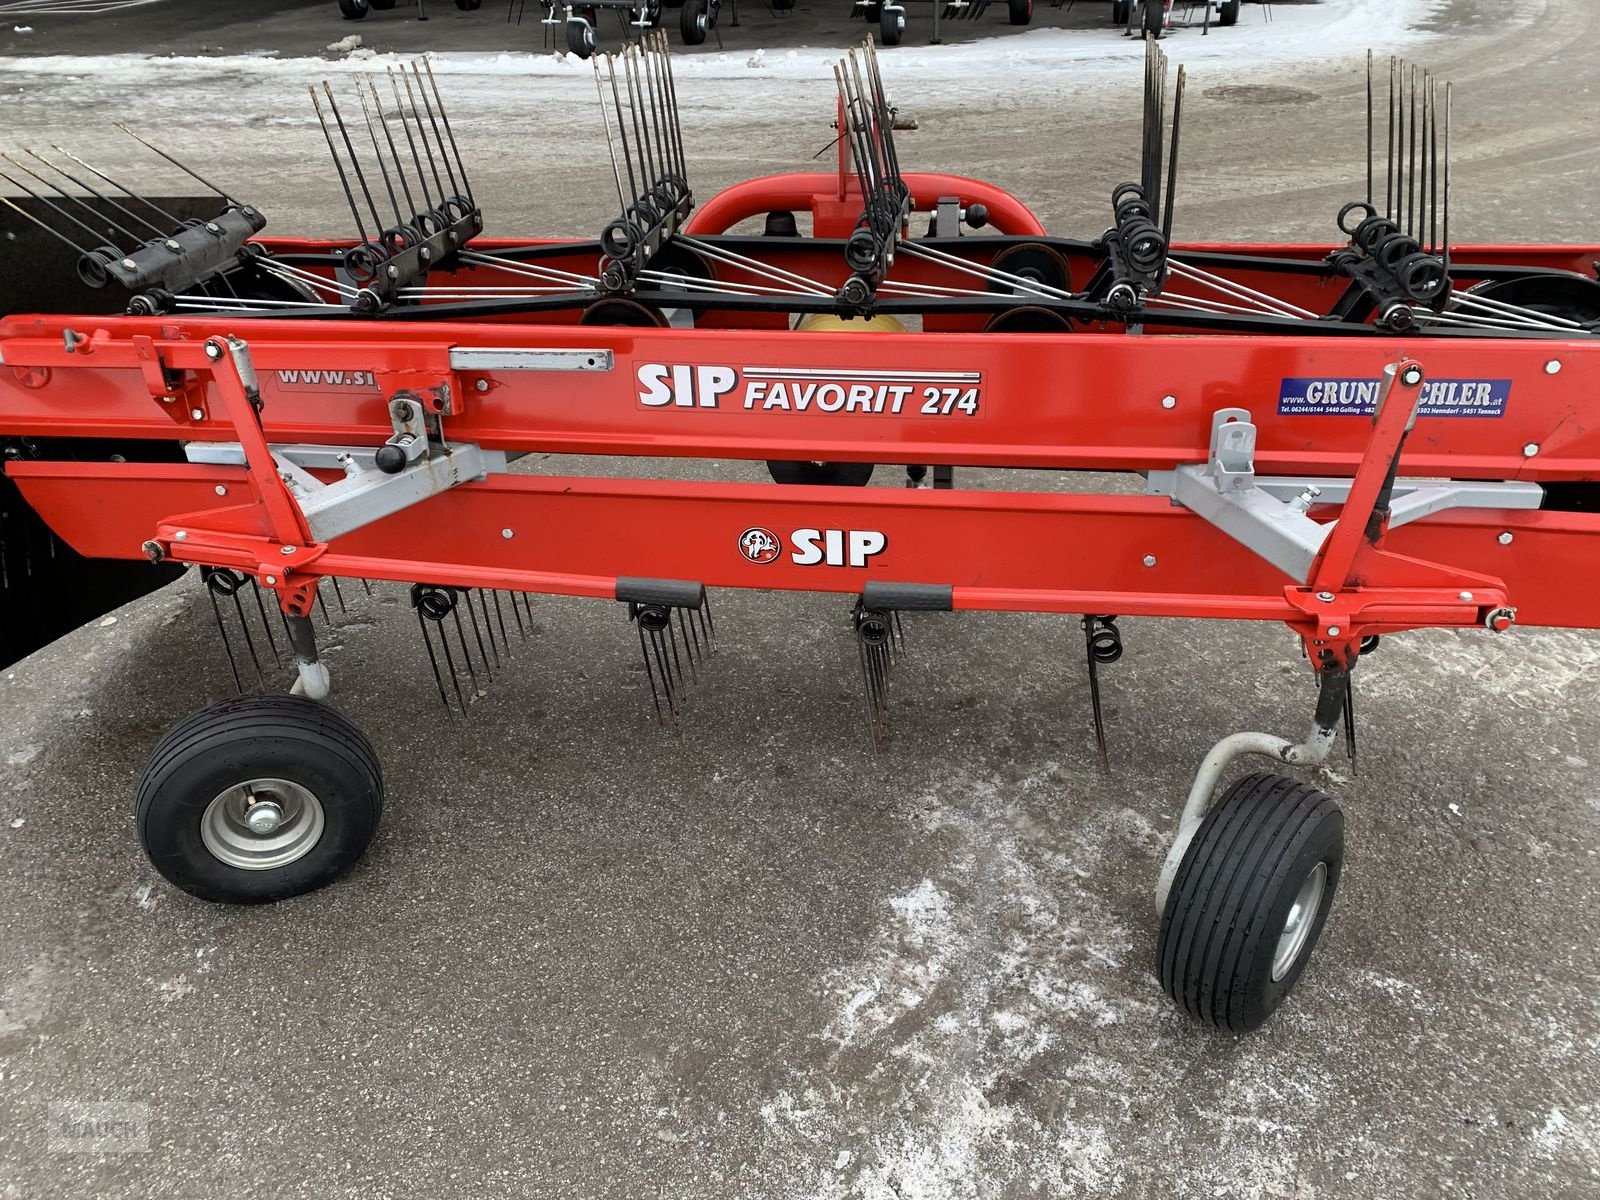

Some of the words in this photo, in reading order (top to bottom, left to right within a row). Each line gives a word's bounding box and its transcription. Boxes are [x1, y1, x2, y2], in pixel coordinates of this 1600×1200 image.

[278, 370, 381, 390] www.si
[637, 363, 736, 407] SIP
[743, 381, 914, 413] FAVORIT
[920, 388, 979, 415] 274
[1340, 406, 1361, 415] Golling
[790, 528, 886, 567] SIP
